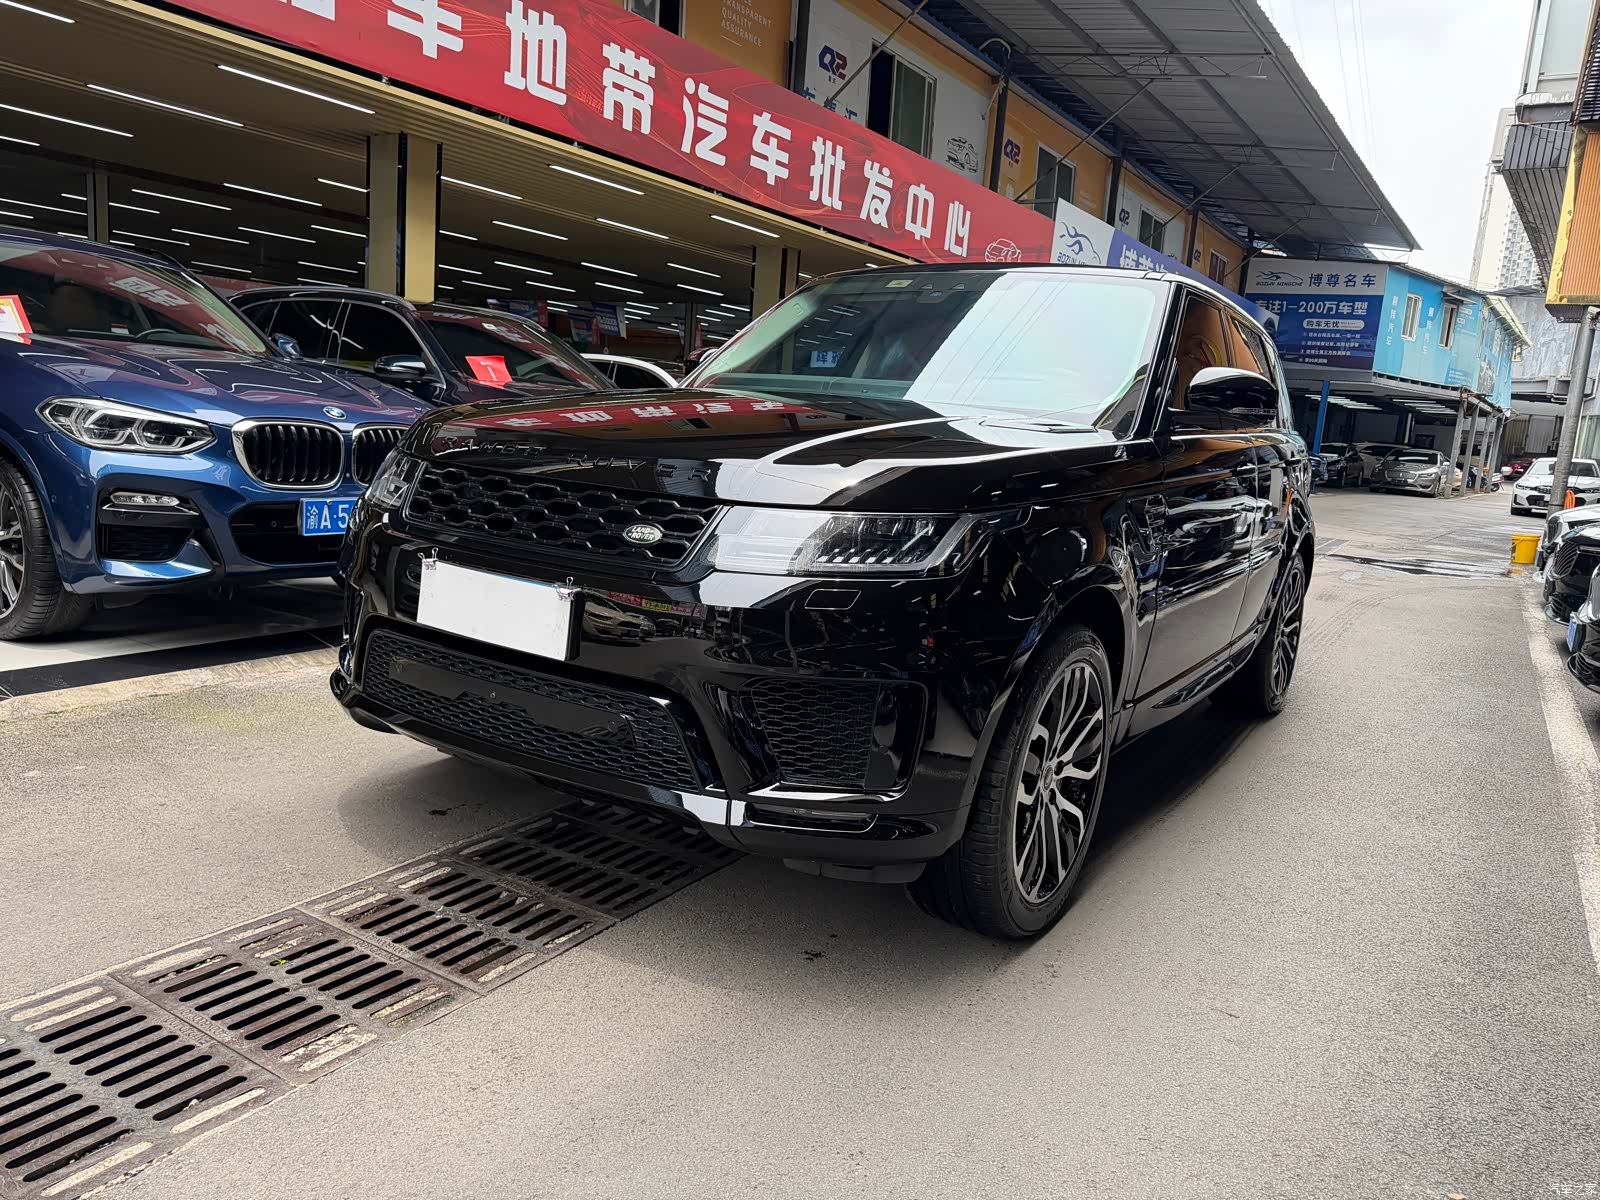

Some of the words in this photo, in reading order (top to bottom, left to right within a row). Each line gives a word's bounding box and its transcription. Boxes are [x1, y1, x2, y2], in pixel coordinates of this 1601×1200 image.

[721, 7, 752, 30] QUALITY
[721, 19, 762, 47] ASSURANCE
[265, 0, 971, 257] 车地带汽车批发中心
[1308, 273, 1377, 288] 博尊名车
[1305, 319, 1340, 329] 购车无忧
[441, 436, 545, 459] RANGE
[567, 453, 712, 482] ROVER
[630, 532, 655, 541] ROVER
